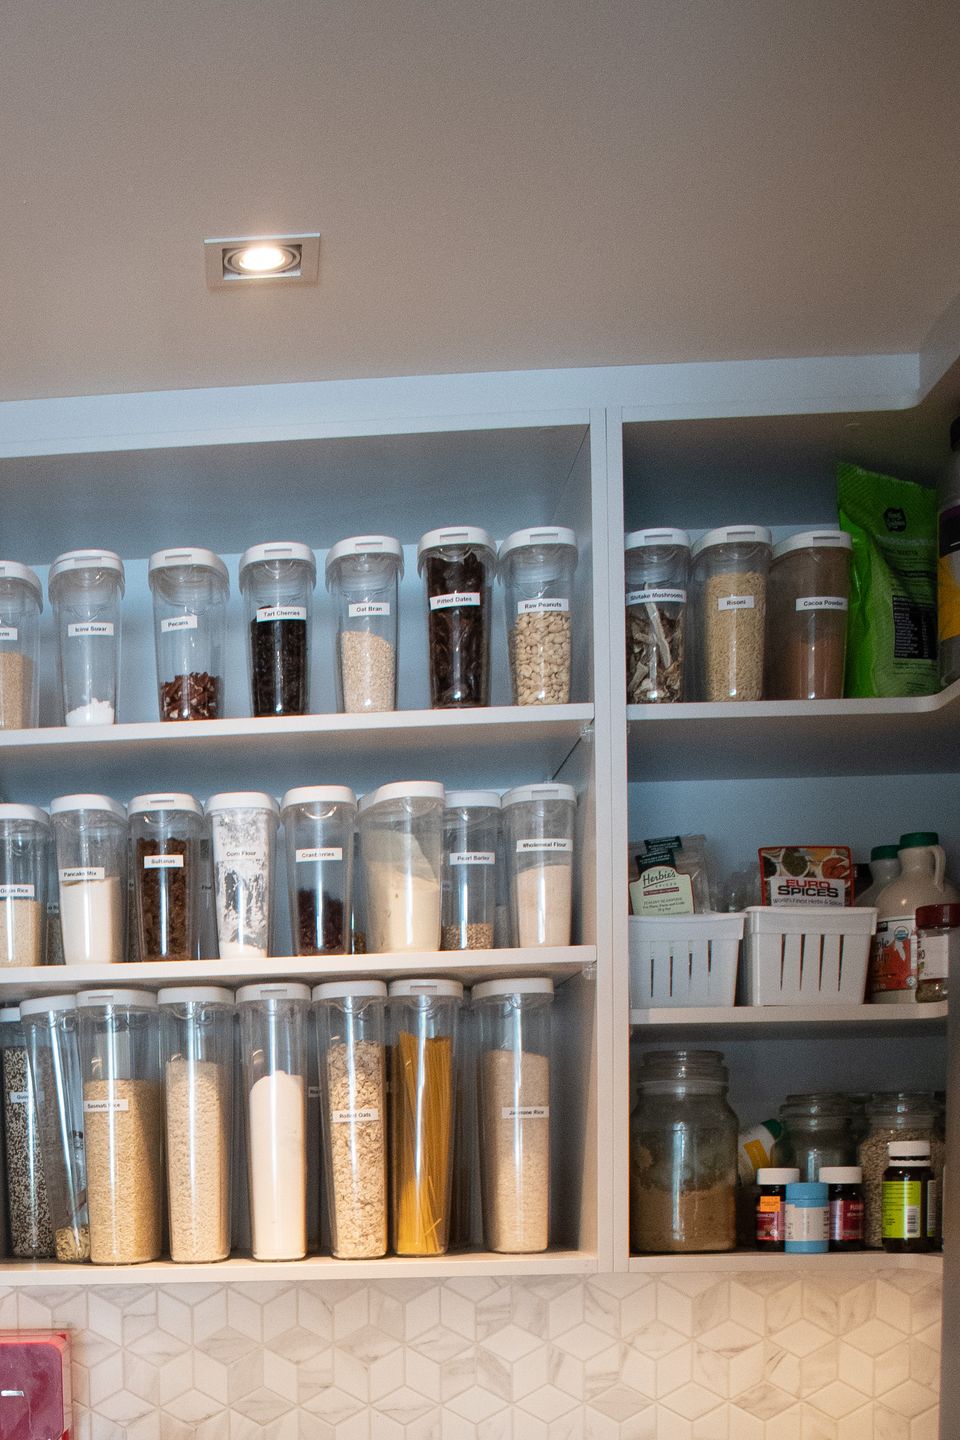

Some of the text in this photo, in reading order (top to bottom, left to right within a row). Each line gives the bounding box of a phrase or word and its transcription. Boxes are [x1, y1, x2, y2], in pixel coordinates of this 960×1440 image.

[643, 870, 676, 886] Herbie's
[785, 879, 831, 889] EURO
[777, 885, 839, 898] SPICES
